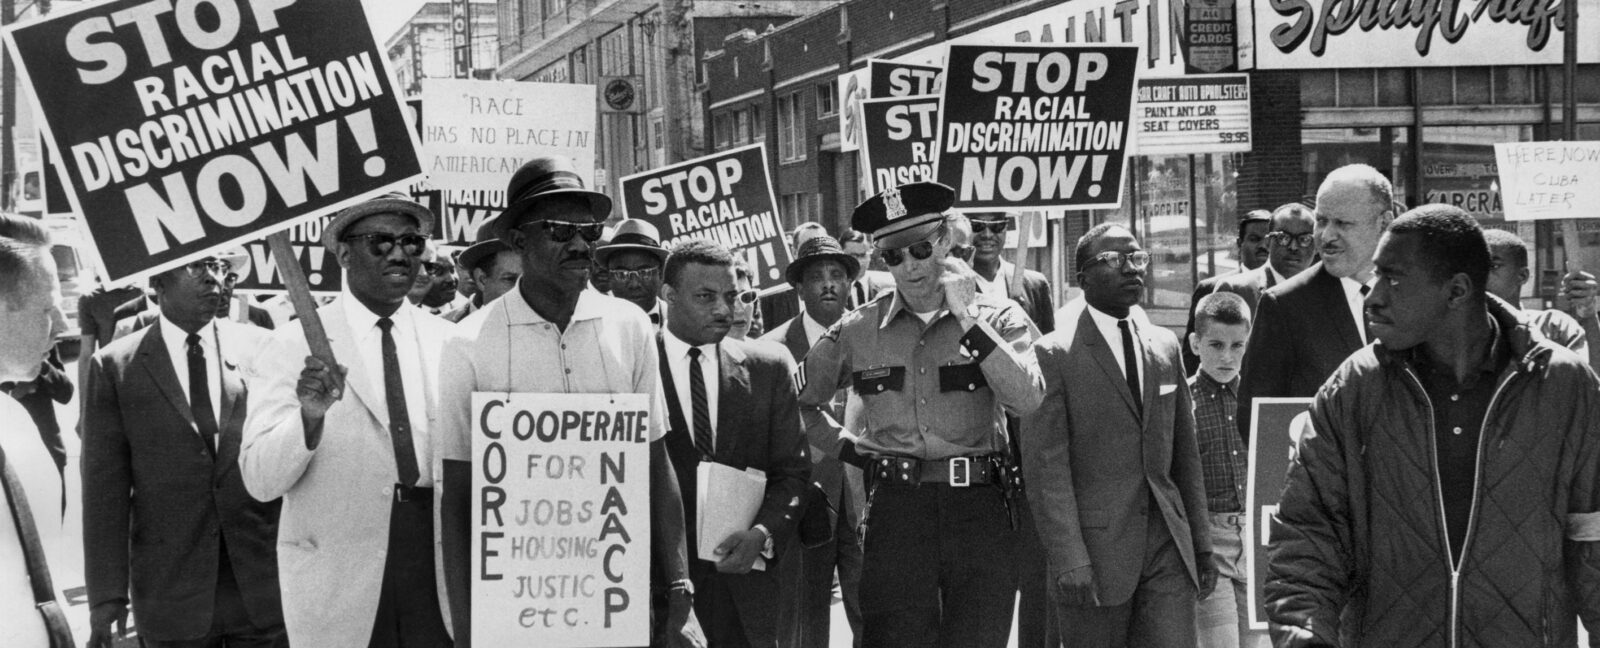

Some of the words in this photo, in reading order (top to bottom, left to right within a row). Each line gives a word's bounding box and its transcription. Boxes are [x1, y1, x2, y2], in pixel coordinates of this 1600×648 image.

[1190, 23, 1233, 33] CREDIT
[1190, 33, 1233, 44] CARDS
[134, 35, 308, 116] RACIAL
[972, 52, 1108, 93] STOP
[995, 96, 1091, 121] RACIAL
[1145, 106, 1174, 118] PAINT
[1177, 106, 1195, 117] ANY
[1198, 105, 1217, 117] CAR
[71, 51, 383, 192] DISCRIMINATION
[1143, 121, 1169, 132] SEAT
[1178, 119, 1220, 131] COVERS
[427, 126, 458, 144] HAS
[471, 127, 496, 145] NO
[507, 128, 560, 148] PLACE
[567, 131, 588, 148] IN
[947, 121, 1123, 153] DISCRIMINATION
[1507, 147, 1556, 165] HERE
[1560, 147, 1600, 164] NOW
[124, 108, 386, 256] NOW!
[641, 158, 743, 215] STOP
[960, 154, 1108, 202] NOW!
[1533, 173, 1579, 186] CUBA
[1515, 192, 1576, 209] LATER
[669, 198, 744, 236] RACIAL
[526, 454, 586, 480] FOR
[480, 399, 507, 581] CORE
[515, 499, 594, 526] JOBS
[511, 536, 597, 561] HOUSING
[599, 451, 632, 629] NAACP
[513, 574, 596, 599] JUSTIC
[518, 607, 589, 629] etc.
